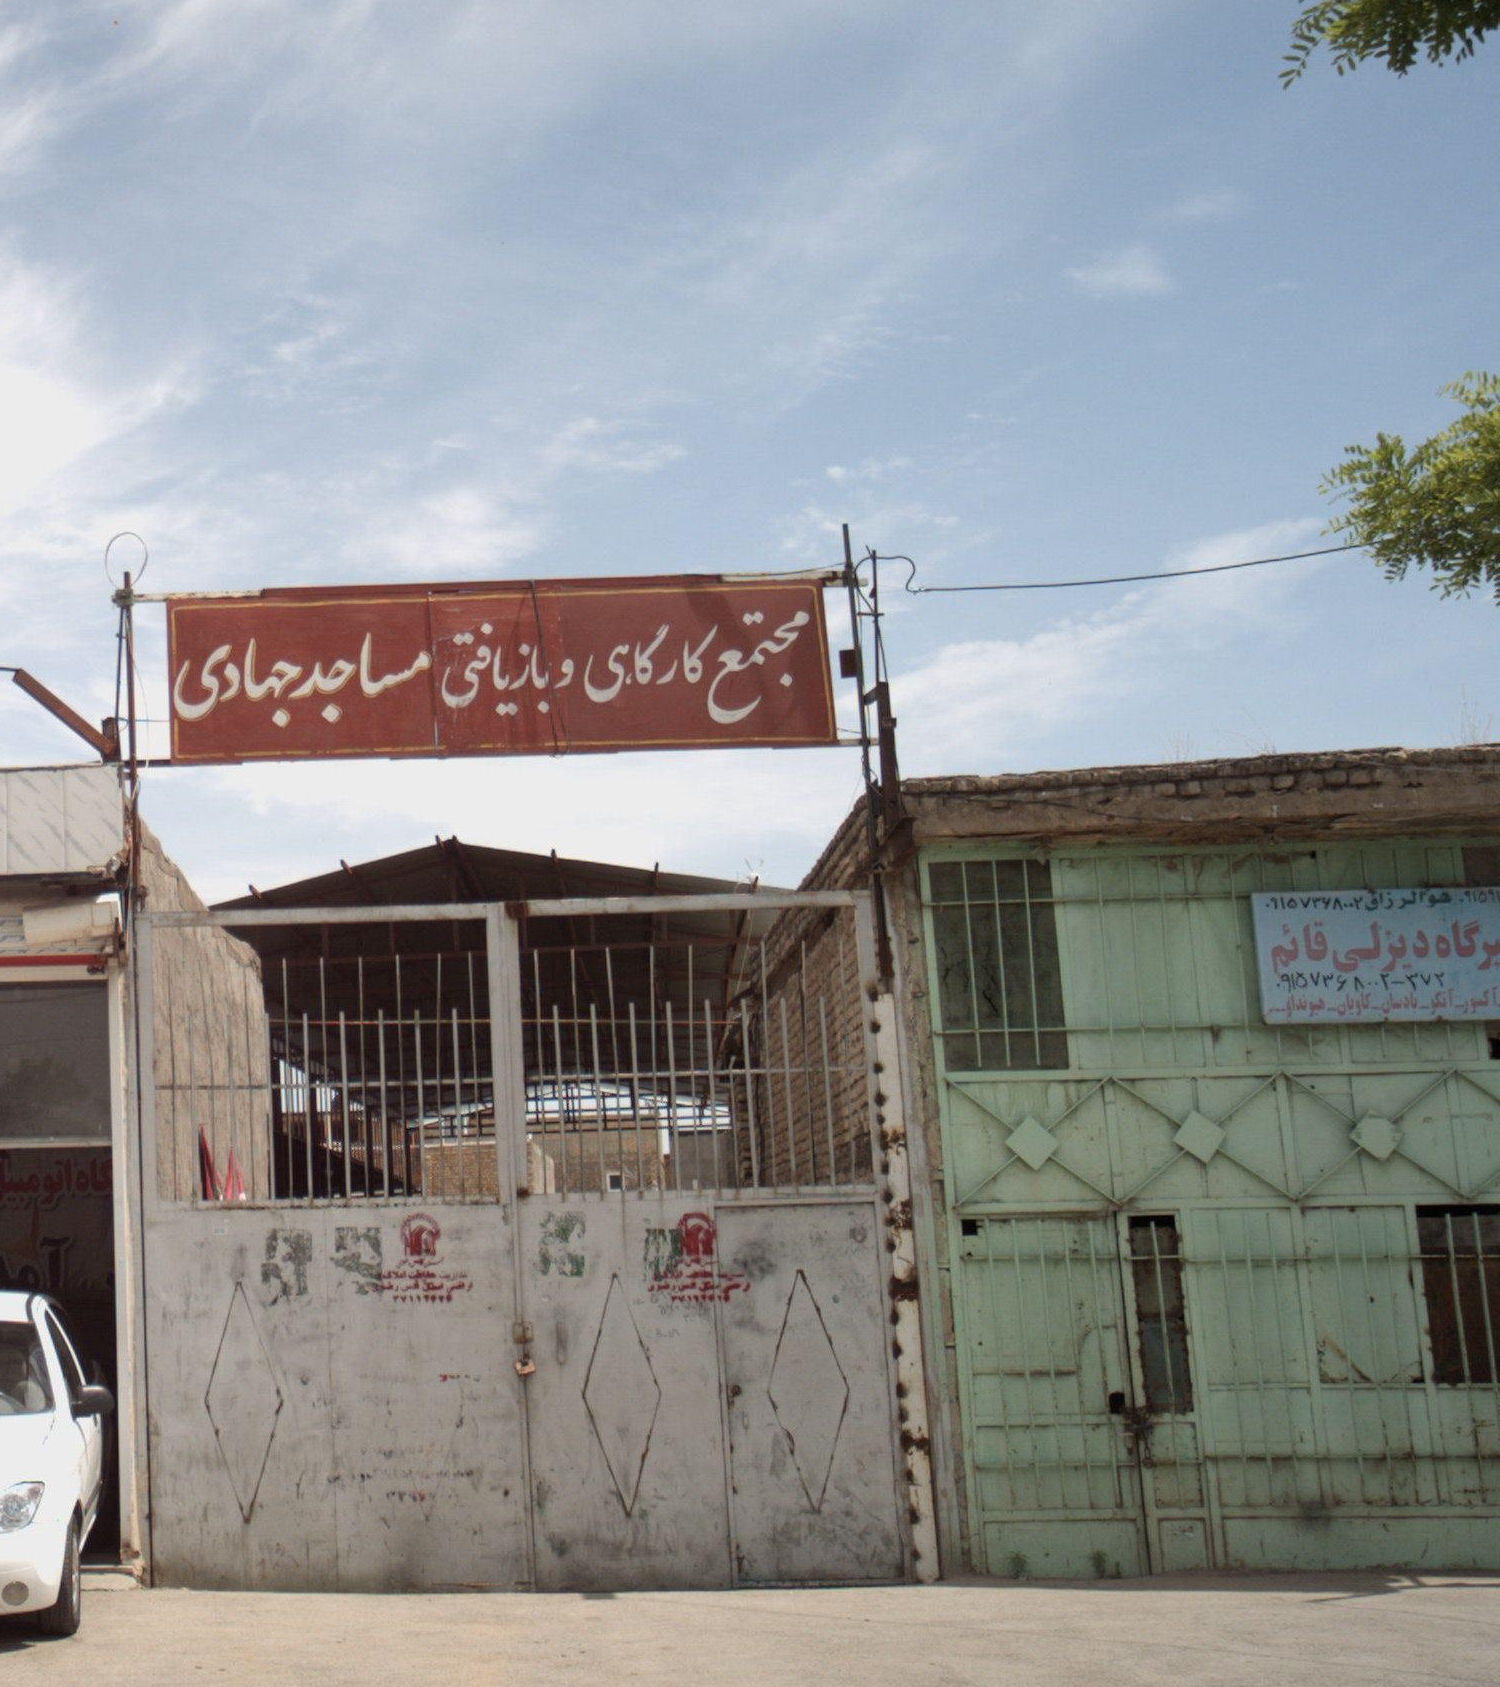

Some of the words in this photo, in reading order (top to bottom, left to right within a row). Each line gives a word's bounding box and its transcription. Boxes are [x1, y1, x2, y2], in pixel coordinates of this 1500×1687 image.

[173, 637, 303, 728] جهادی
[287, 631, 432, 724] مساجد
[584, 623, 719, 703] کارگاهی
[707, 610, 810, 724] مجتمع
